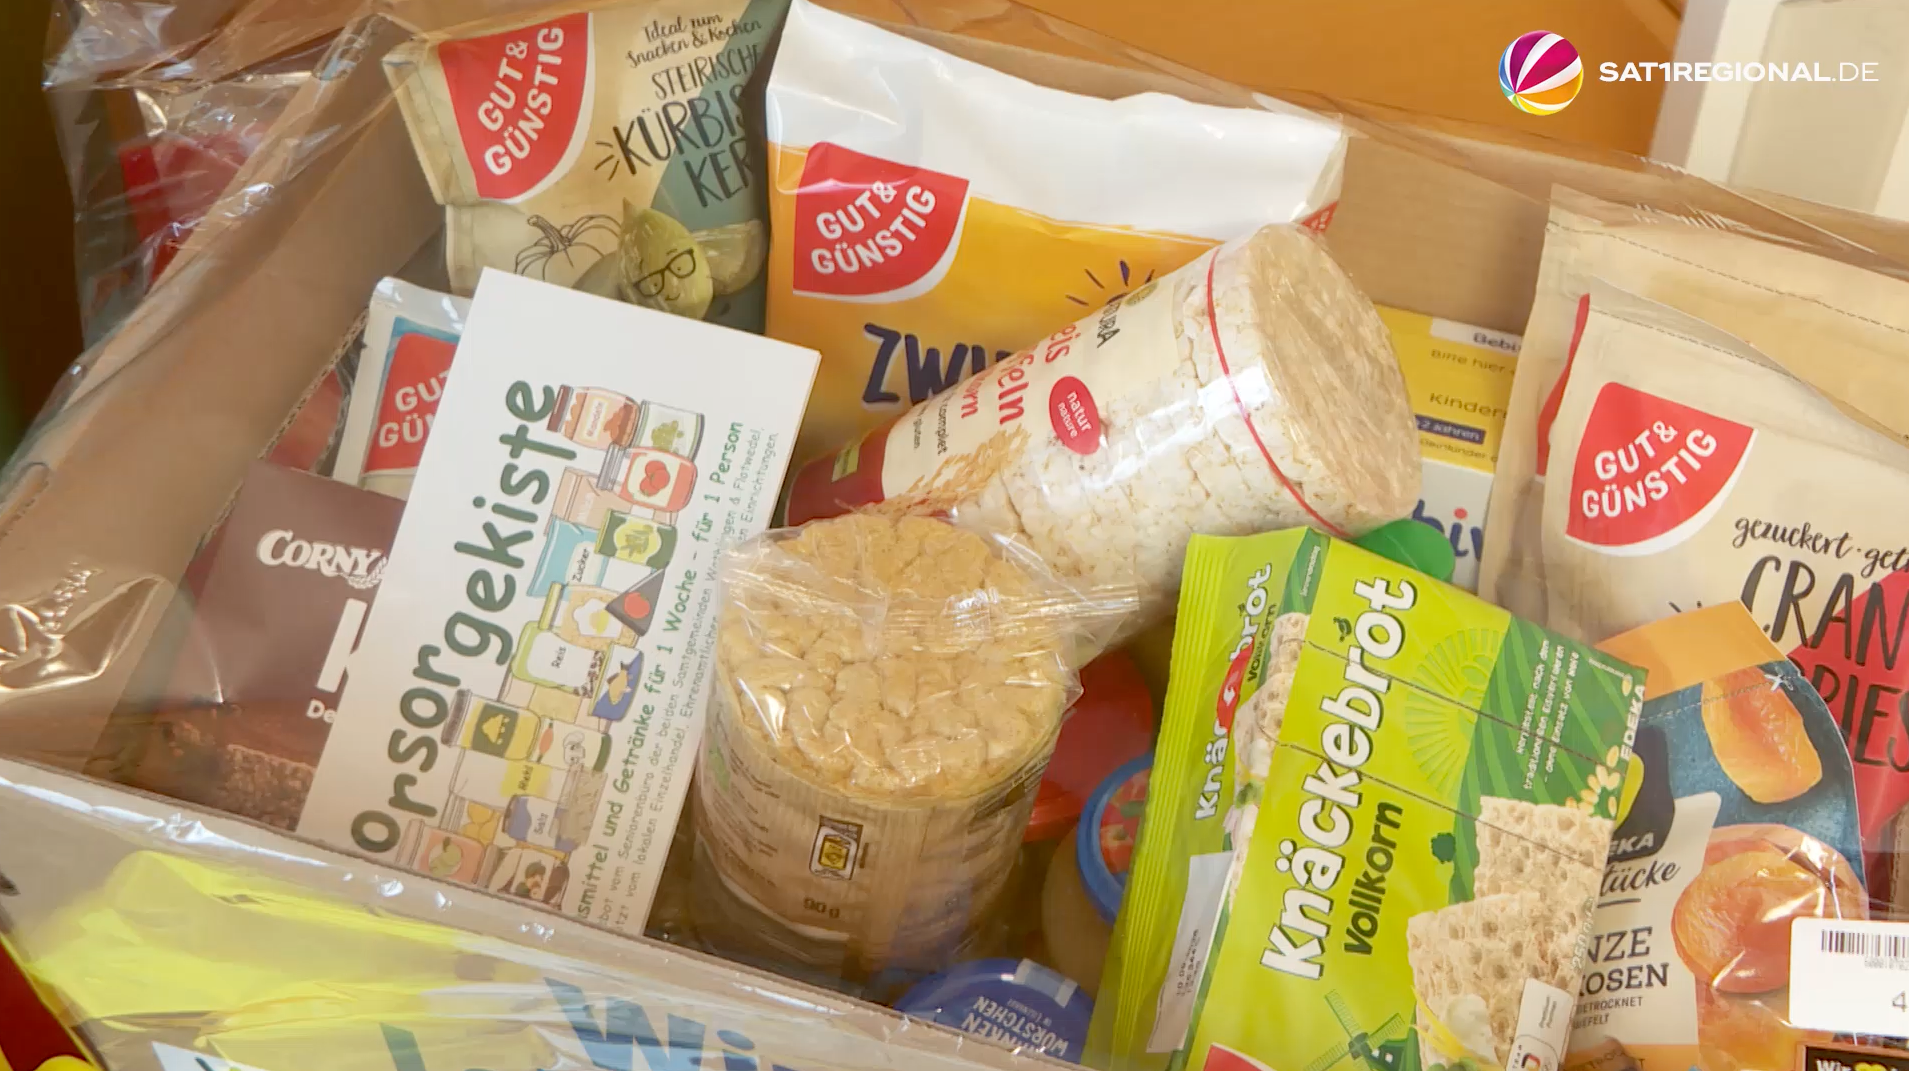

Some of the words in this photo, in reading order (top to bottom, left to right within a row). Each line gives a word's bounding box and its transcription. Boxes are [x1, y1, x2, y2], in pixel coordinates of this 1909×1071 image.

[625, 38, 690, 68] Snacken
[692, 30, 707, 49] &
[709, 19, 762, 42] Kochen
[644, 16, 686, 43] Ideal
[690, 14, 723, 28] zum
[485, 27, 564, 176] GÜNSTIG
[810, 185, 937, 275] GÜNSTIG
[862, 322, 1012, 406] ZWI
[1057, 402, 1078, 439] nature
[1066, 391, 1092, 433] natur
[1582, 428, 1717, 518] GÜNSTIG
[257, 528, 377, 581] CORNY
[572, 548, 592, 583] Zucker
[1732, 516, 1853, 559] gezuckert
[350, 380, 577, 852] orsorgekiste
[596, 799, 623, 837] und
[610, 700, 656, 794] Getränke
[641, 660, 668, 694] für
[661, 566, 698, 634] Woche
[690, 509, 716, 543] für
[708, 419, 744, 485] Person
[1621, 685, 1645, 761] EDEKA
[1790, 656, 1909, 773] RIES
[1260, 576, 1416, 981] Knäckebrot
[1344, 802, 1403, 956] Vollkorn
[1579, 962, 1669, 997] OSEN
